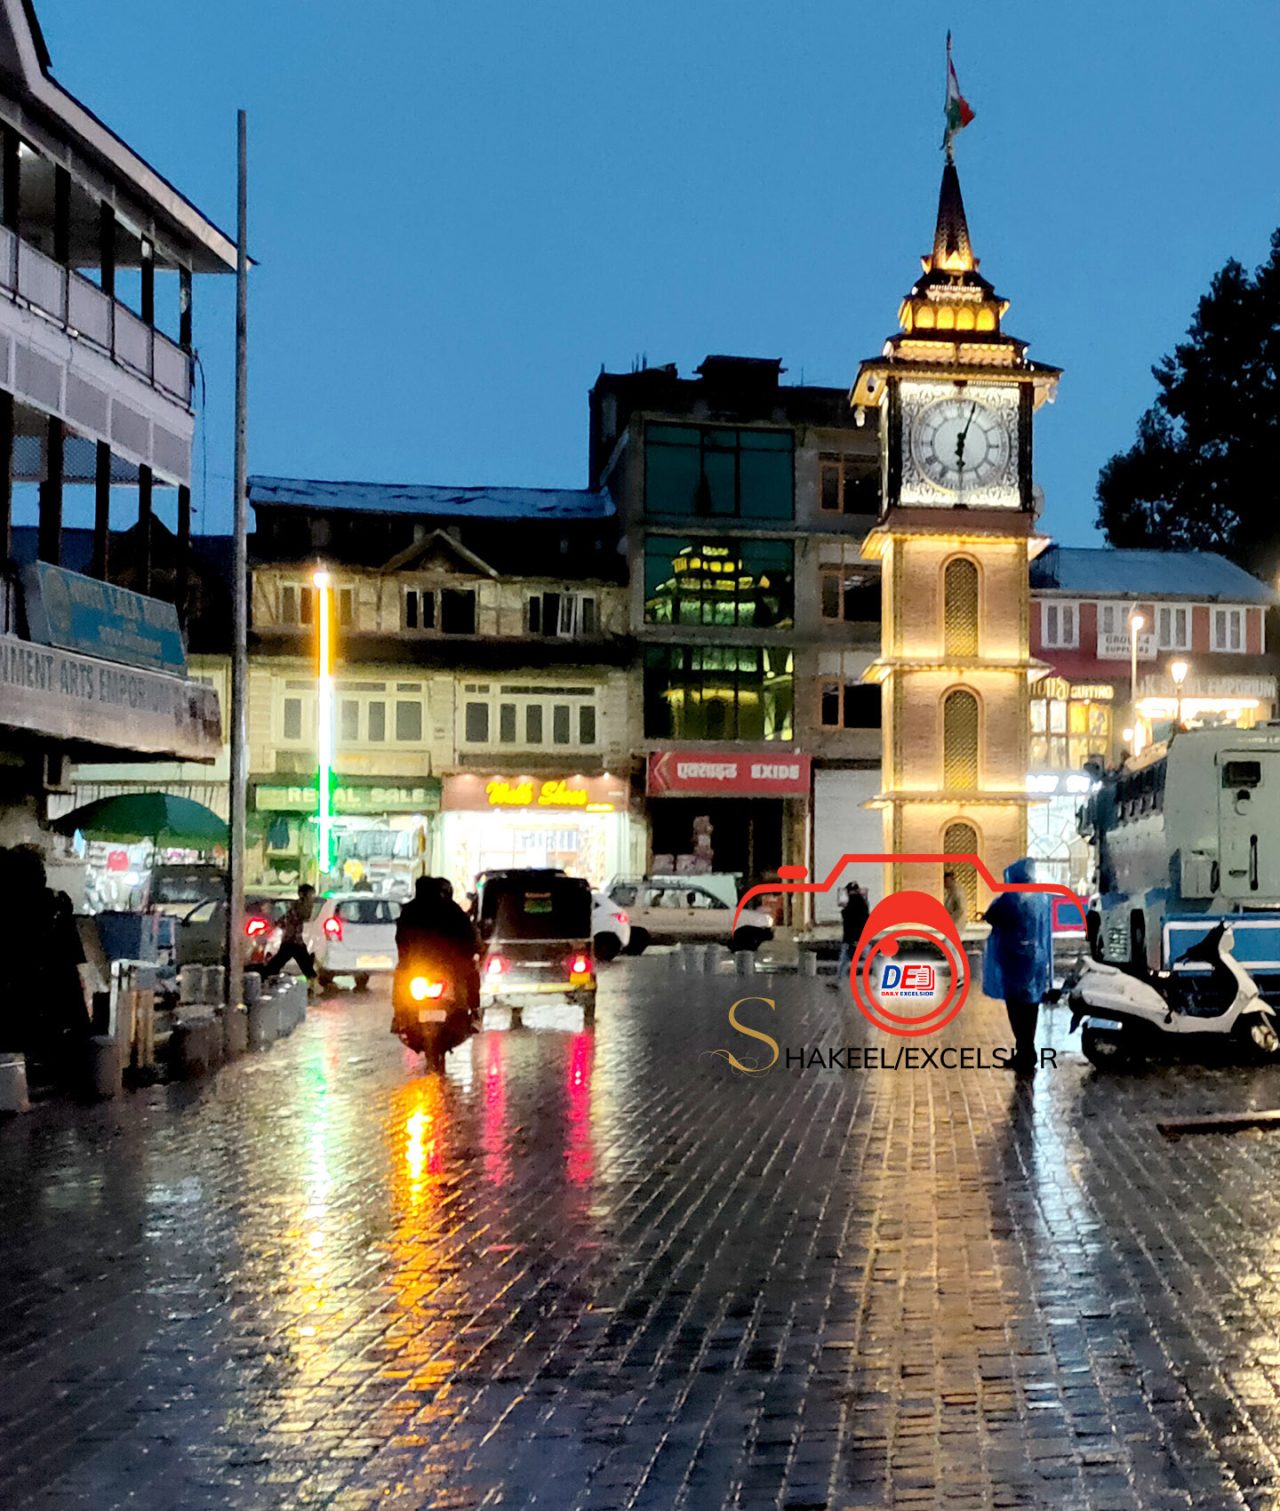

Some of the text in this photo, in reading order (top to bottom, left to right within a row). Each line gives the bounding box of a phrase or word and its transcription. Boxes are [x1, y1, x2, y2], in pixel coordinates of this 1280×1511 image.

[1105, 645, 1149, 654] SUPPLRS
[60, 659, 94, 700] ARTS
[751, 763, 800, 780] EXIDE
[287, 785, 425, 804] REAL SALE
